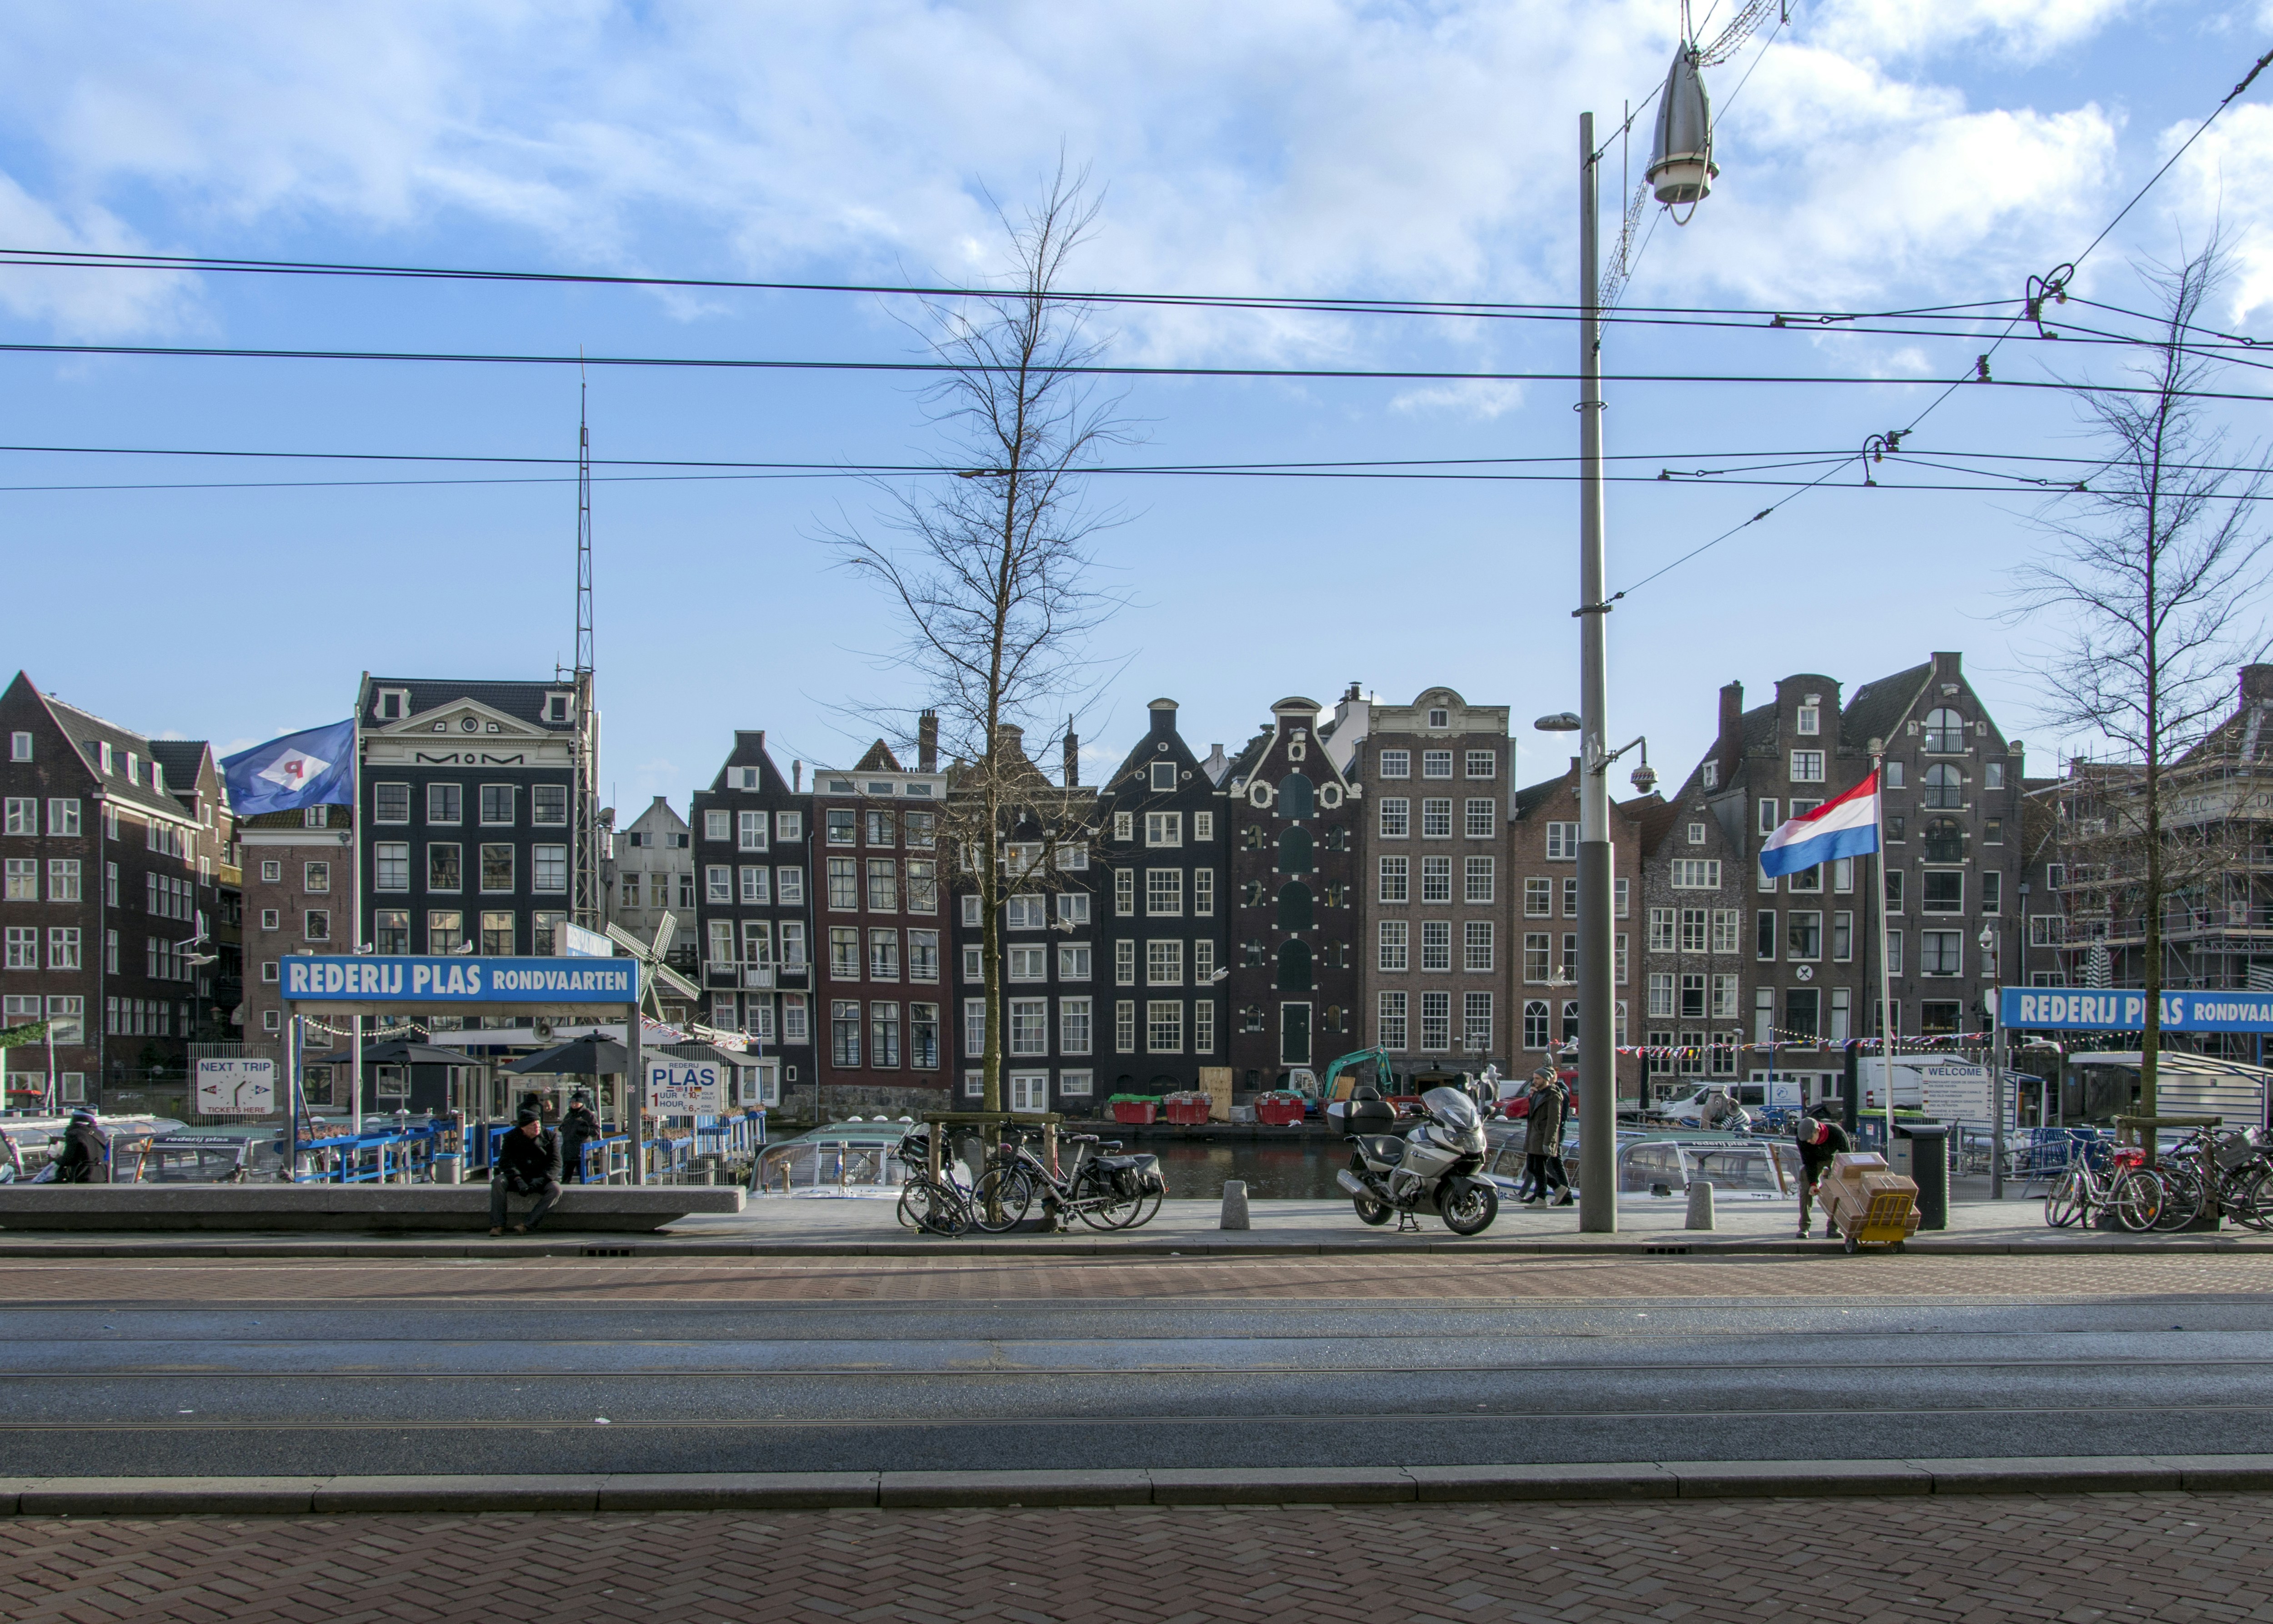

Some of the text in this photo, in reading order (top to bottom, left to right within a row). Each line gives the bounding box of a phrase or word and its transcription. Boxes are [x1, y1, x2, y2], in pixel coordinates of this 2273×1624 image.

[2257, 793, 2273, 808] D
[290, 963, 627, 995] REDERIJ PLAS RONDVAARTEN
[2020, 995, 2117, 1023] REDERIJ
[201, 1063, 270, 1071] NEXT TRIP
[653, 1068, 715, 1086] PLAS
[651, 1093, 658, 1107] 1
[1498, 1188, 1507, 1200] las
